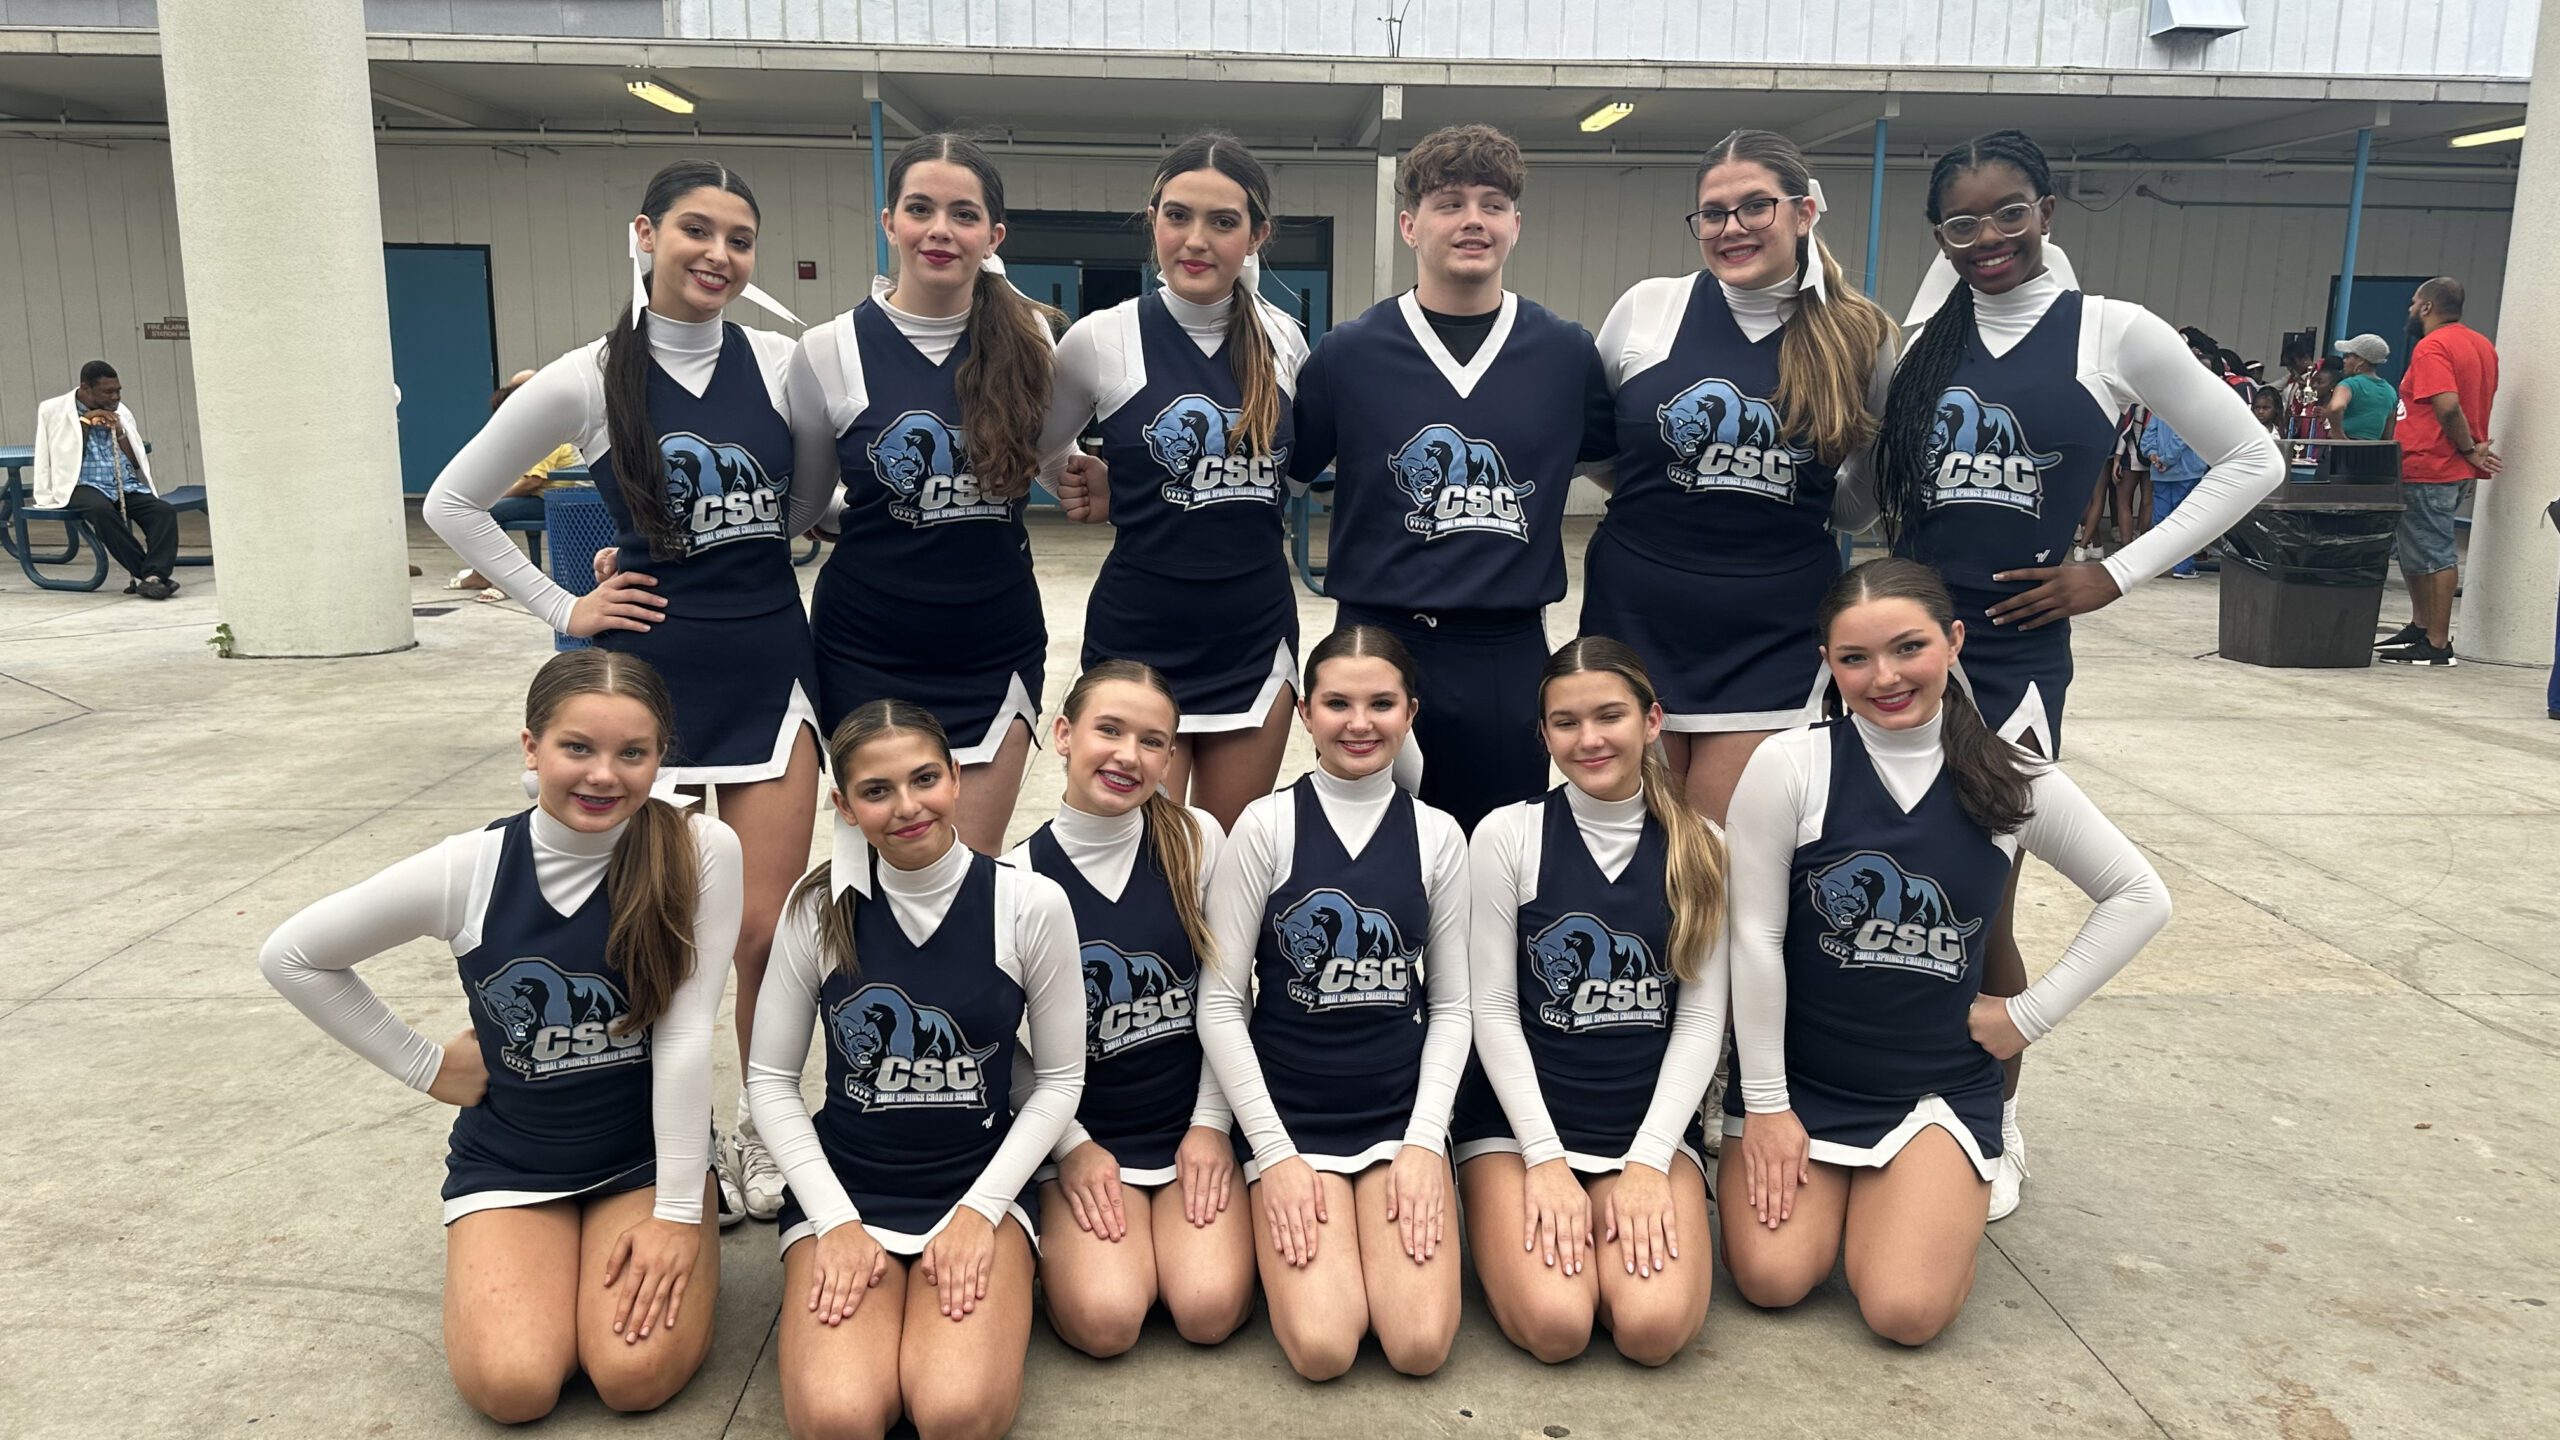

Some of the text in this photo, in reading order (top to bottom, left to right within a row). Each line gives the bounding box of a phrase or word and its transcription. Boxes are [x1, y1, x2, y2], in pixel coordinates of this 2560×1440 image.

[1191, 454, 1275, 490] CSC
[1697, 442, 1792, 484] CSC
[1936, 451, 2037, 494] CSC
[1716, 476, 1741, 486] SPRINGS
[1955, 488, 1982, 497] SPRINGS
[690, 487, 779, 533] CSC
[1434, 484, 1520, 521] CSC
[1854, 919, 1961, 962] CSC
[1318, 957, 1407, 992] CSC
[1876, 953, 1904, 964] SPRINGS
[1340, 992, 1364, 1003] SPRINGS
[1571, 976, 1662, 1014] CSC
[1099, 987, 1191, 1040] CSC
[1594, 1012, 1619, 1023] SPRINGS
[1123, 1029, 1147, 1044] SPRINGS
[559, 1057, 589, 1069] SPRINGS
[875, 1055, 980, 1091] CSC
[897, 1092, 925, 1103] SPRINGS
